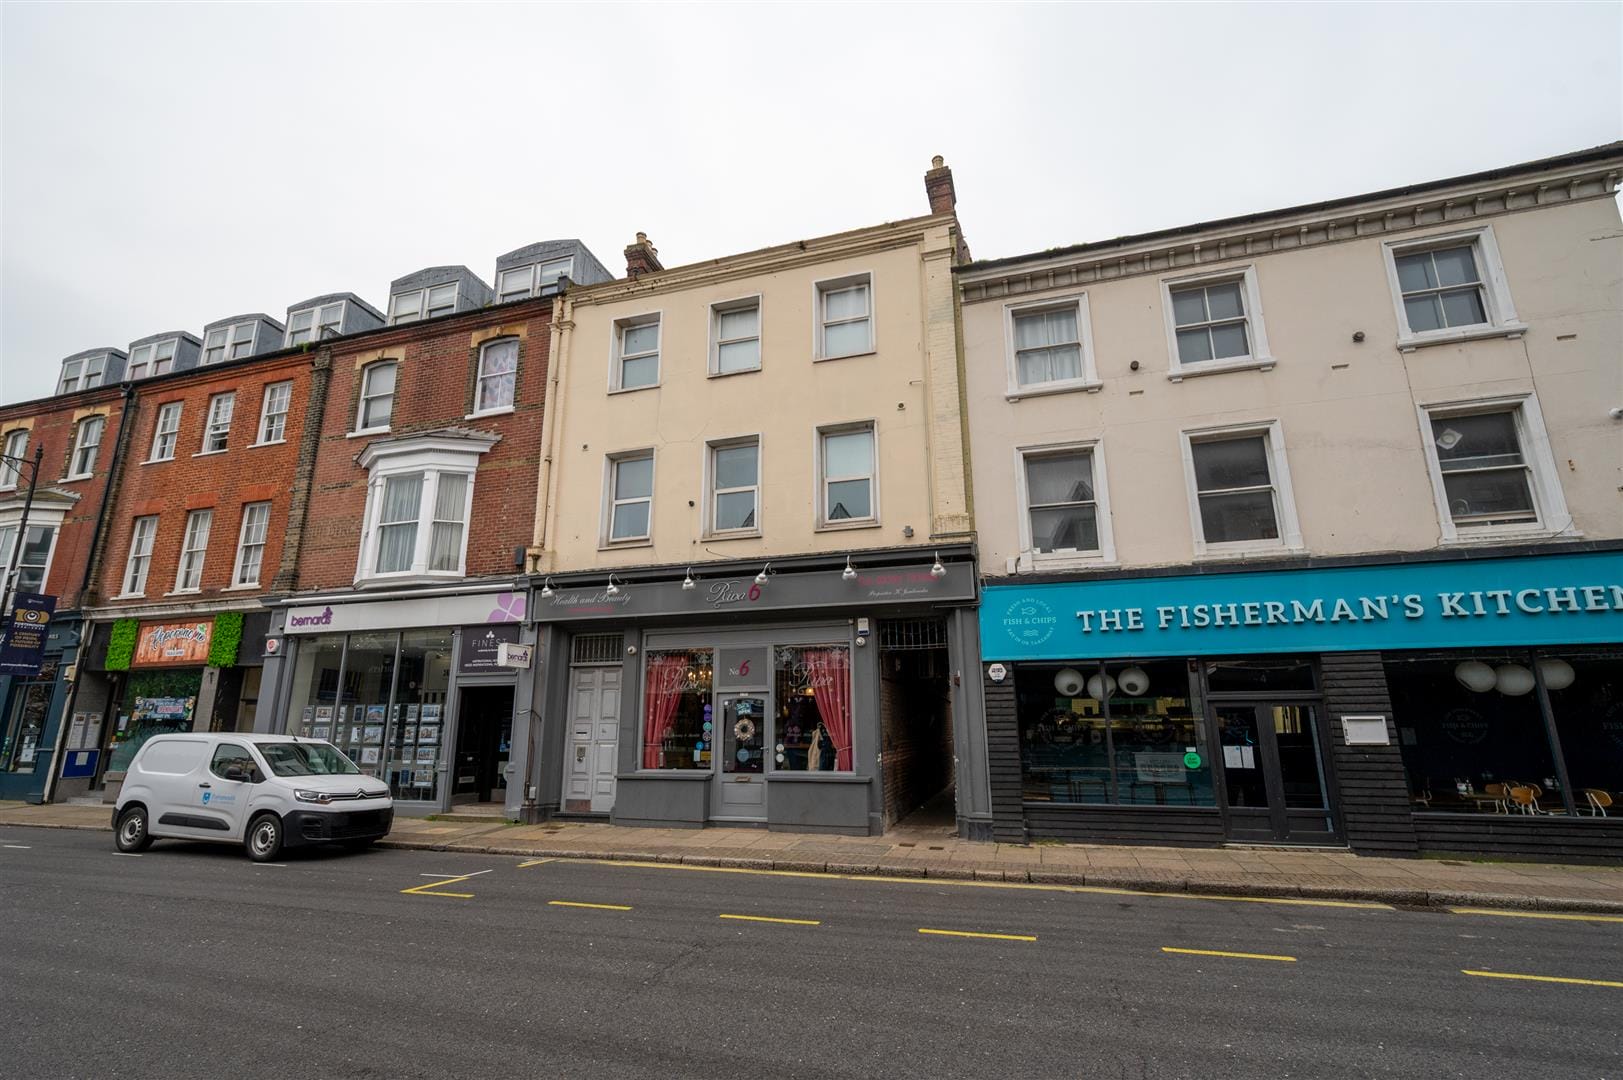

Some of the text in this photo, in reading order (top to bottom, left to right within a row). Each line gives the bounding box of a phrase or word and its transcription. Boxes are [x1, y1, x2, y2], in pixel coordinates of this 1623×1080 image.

[550, 595, 579, 606] Health
[580, 593, 599, 604] and
[1077, 608, 1144, 632] THE
[1156, 594, 1425, 628] FISHERMAN'S
[291, 615, 331, 627] bernards
[1032, 616, 1057, 624] CHIPS
